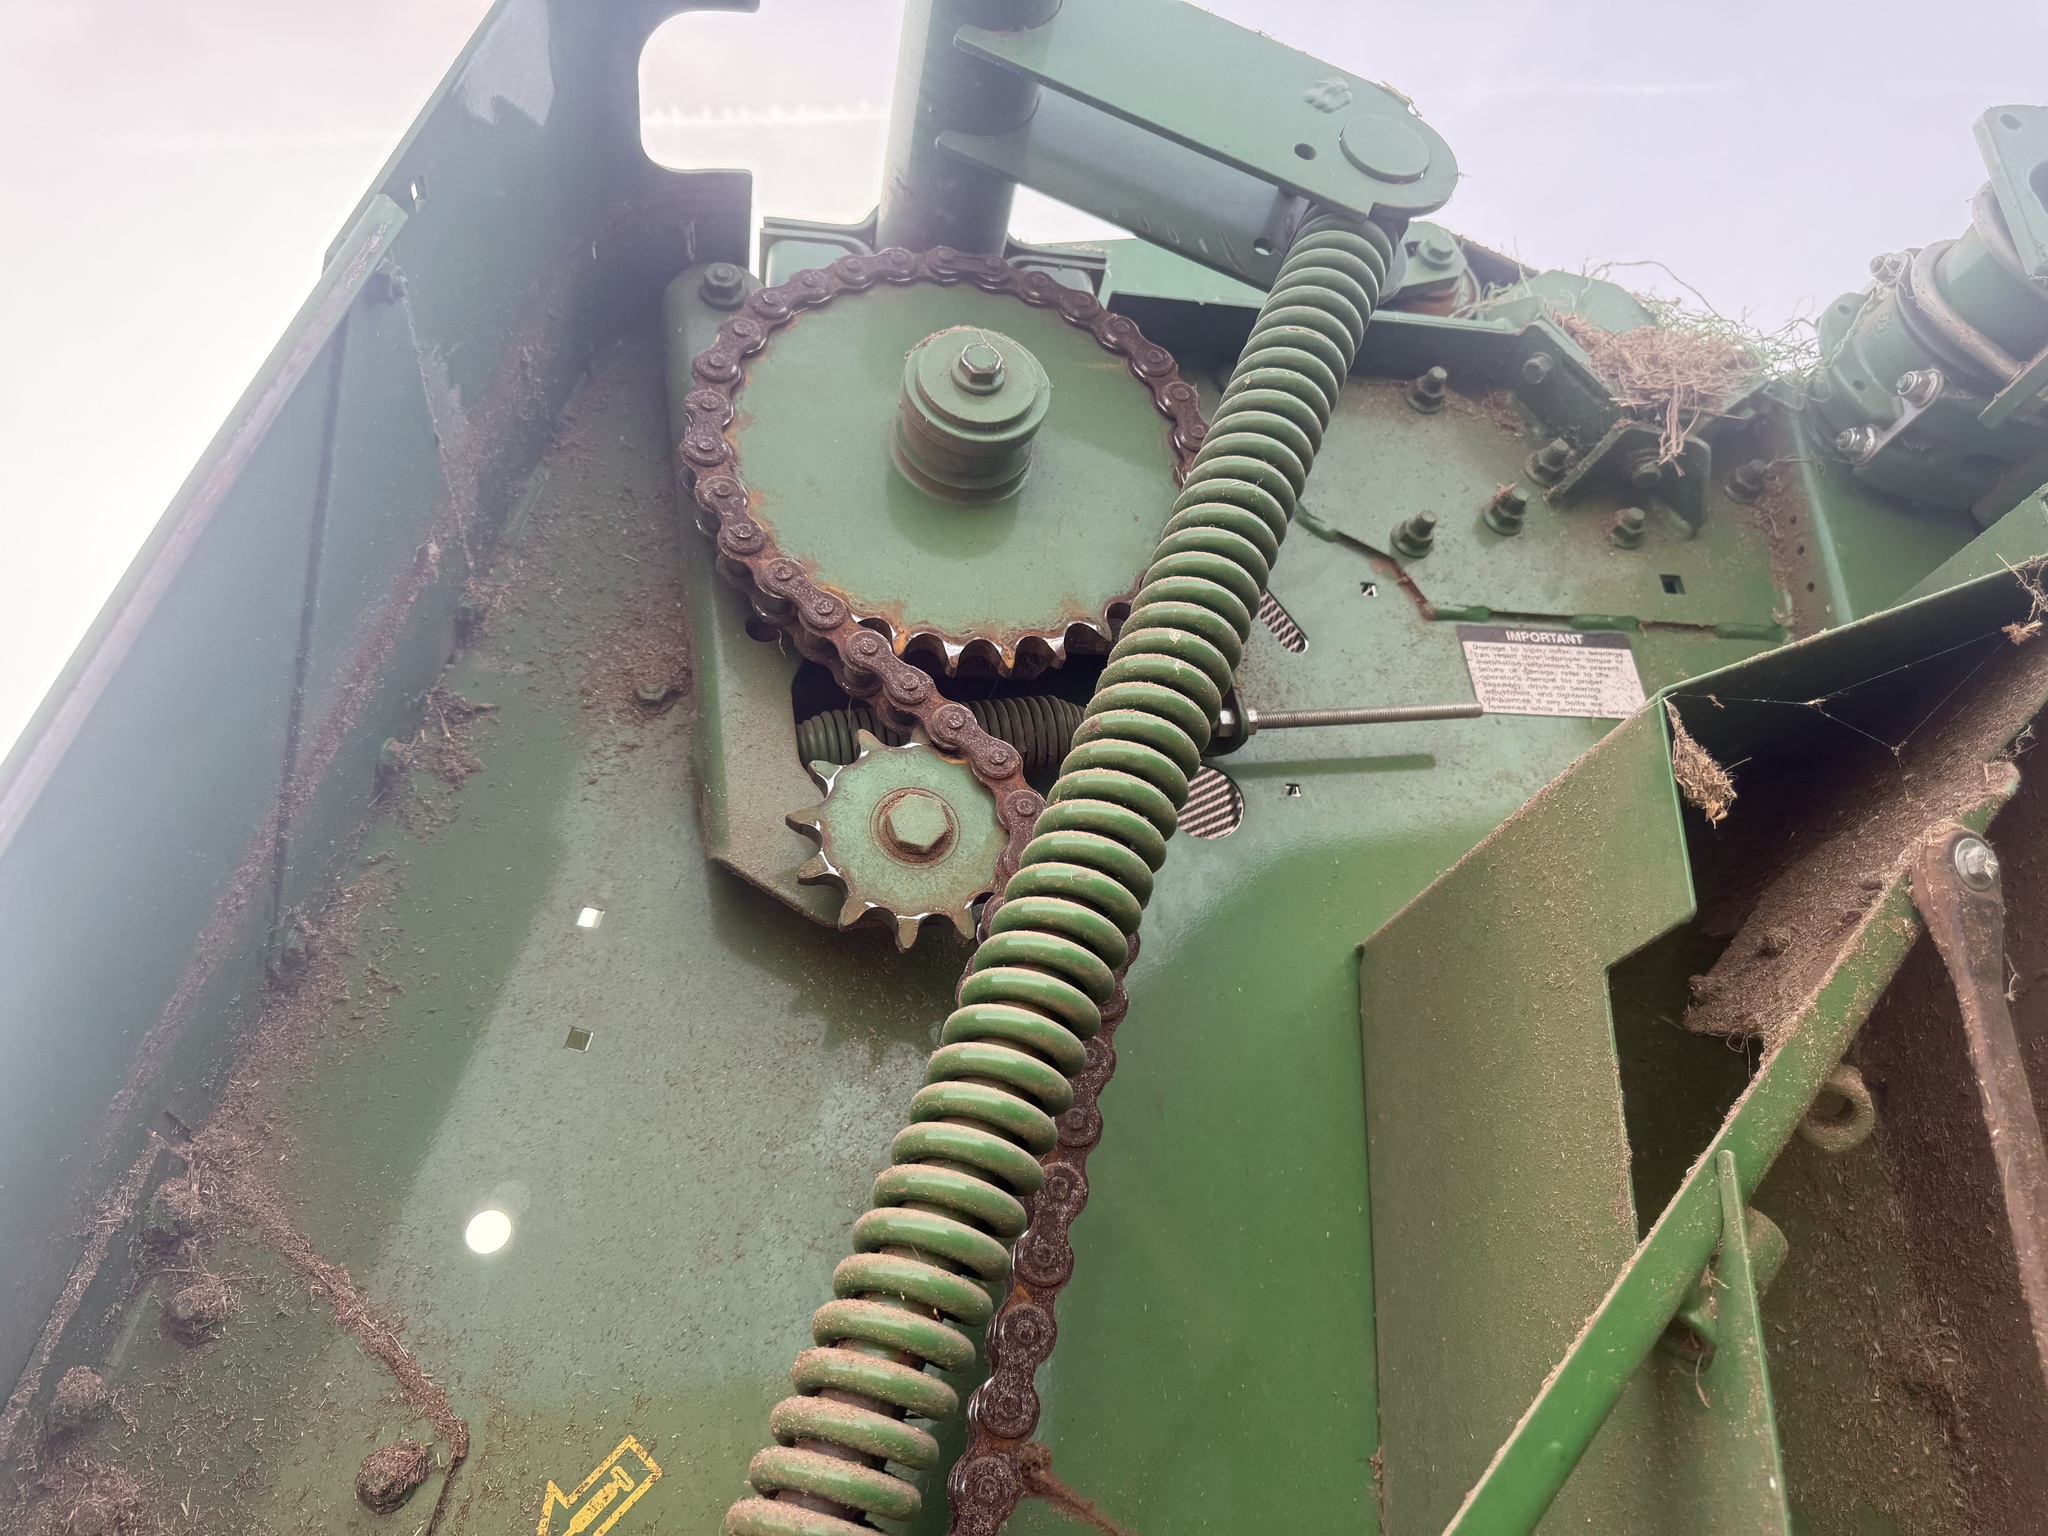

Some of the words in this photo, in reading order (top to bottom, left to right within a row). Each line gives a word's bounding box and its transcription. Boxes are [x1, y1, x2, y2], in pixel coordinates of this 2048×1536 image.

[1506, 631, 1583, 644] IMPORTANT
[1472, 644, 1505, 652] Damage
[1577, 678, 1602, 686] proper
[1570, 685, 1600, 693] bearing
